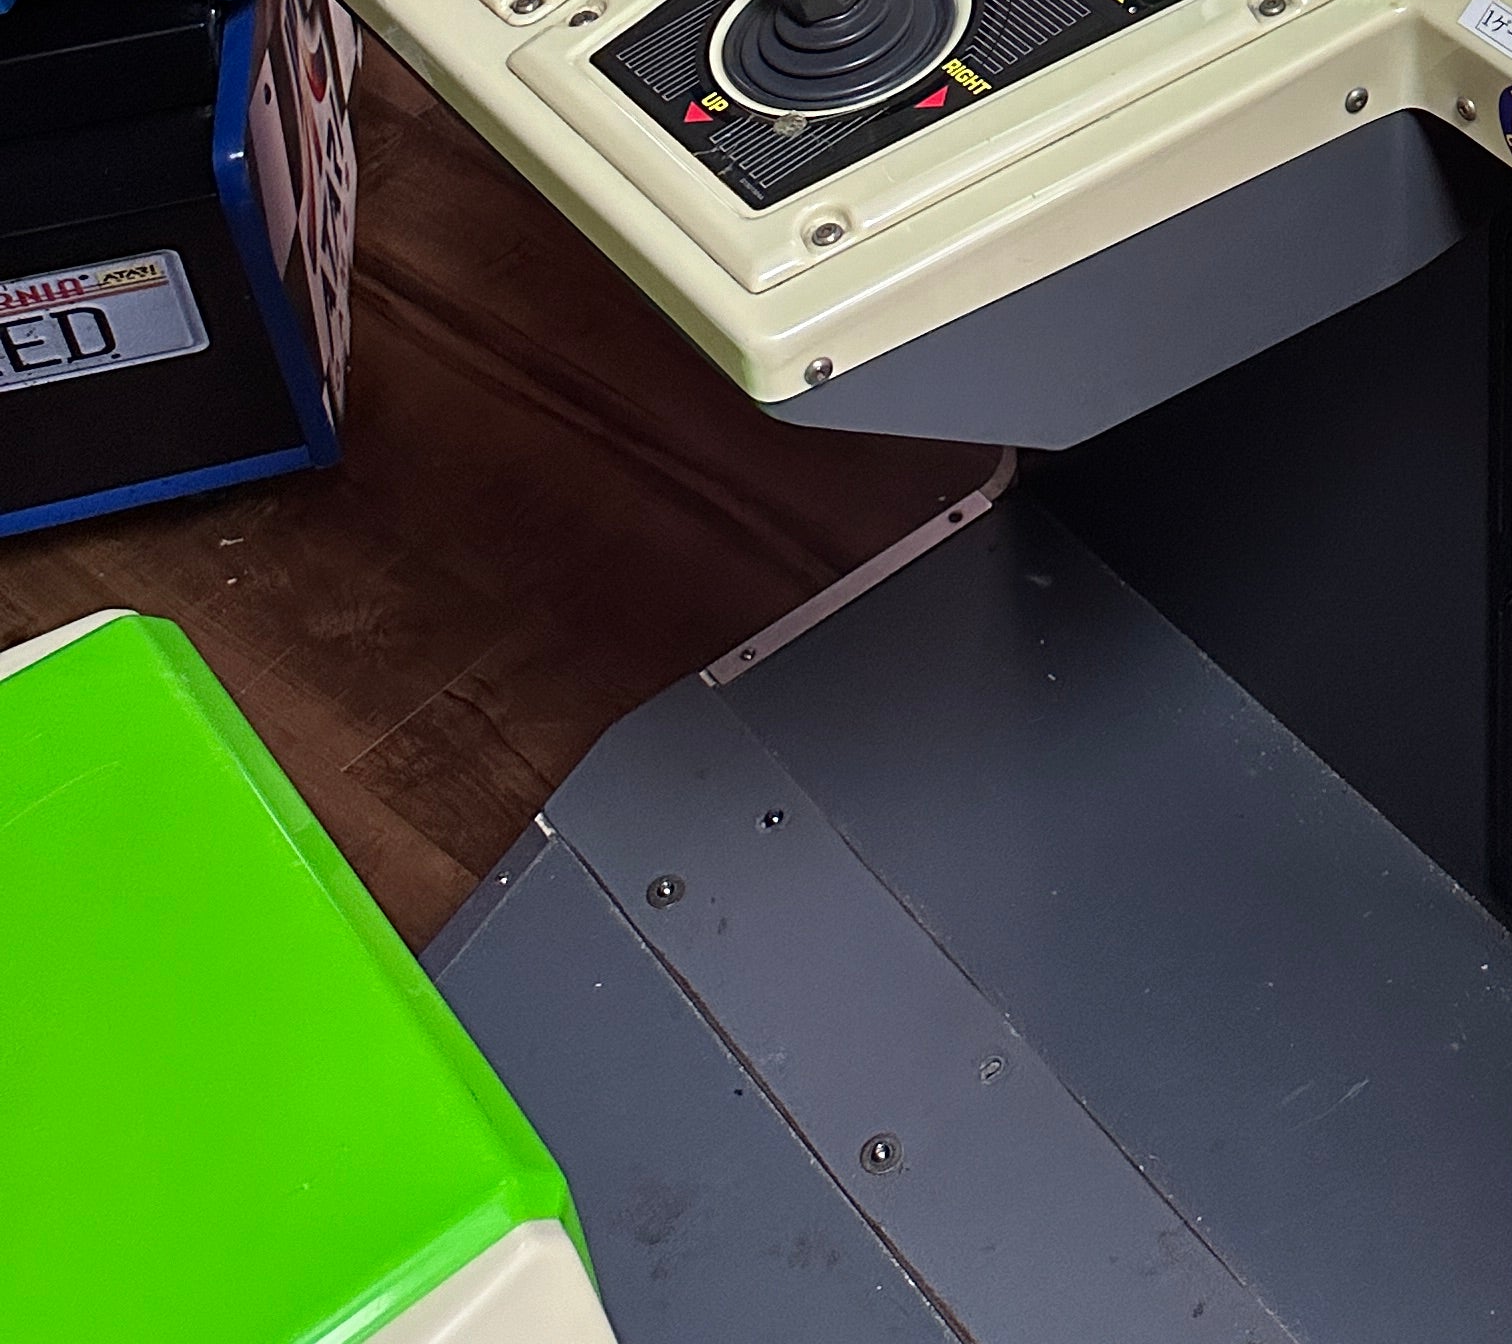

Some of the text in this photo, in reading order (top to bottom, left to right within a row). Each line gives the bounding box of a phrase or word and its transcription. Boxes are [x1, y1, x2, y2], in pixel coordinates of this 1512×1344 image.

[942, 58, 992, 95] RIGHT
[701, 92, 729, 111] UP
[103, 265, 156, 281] ATARI
[0, 307, 116, 372] ED
